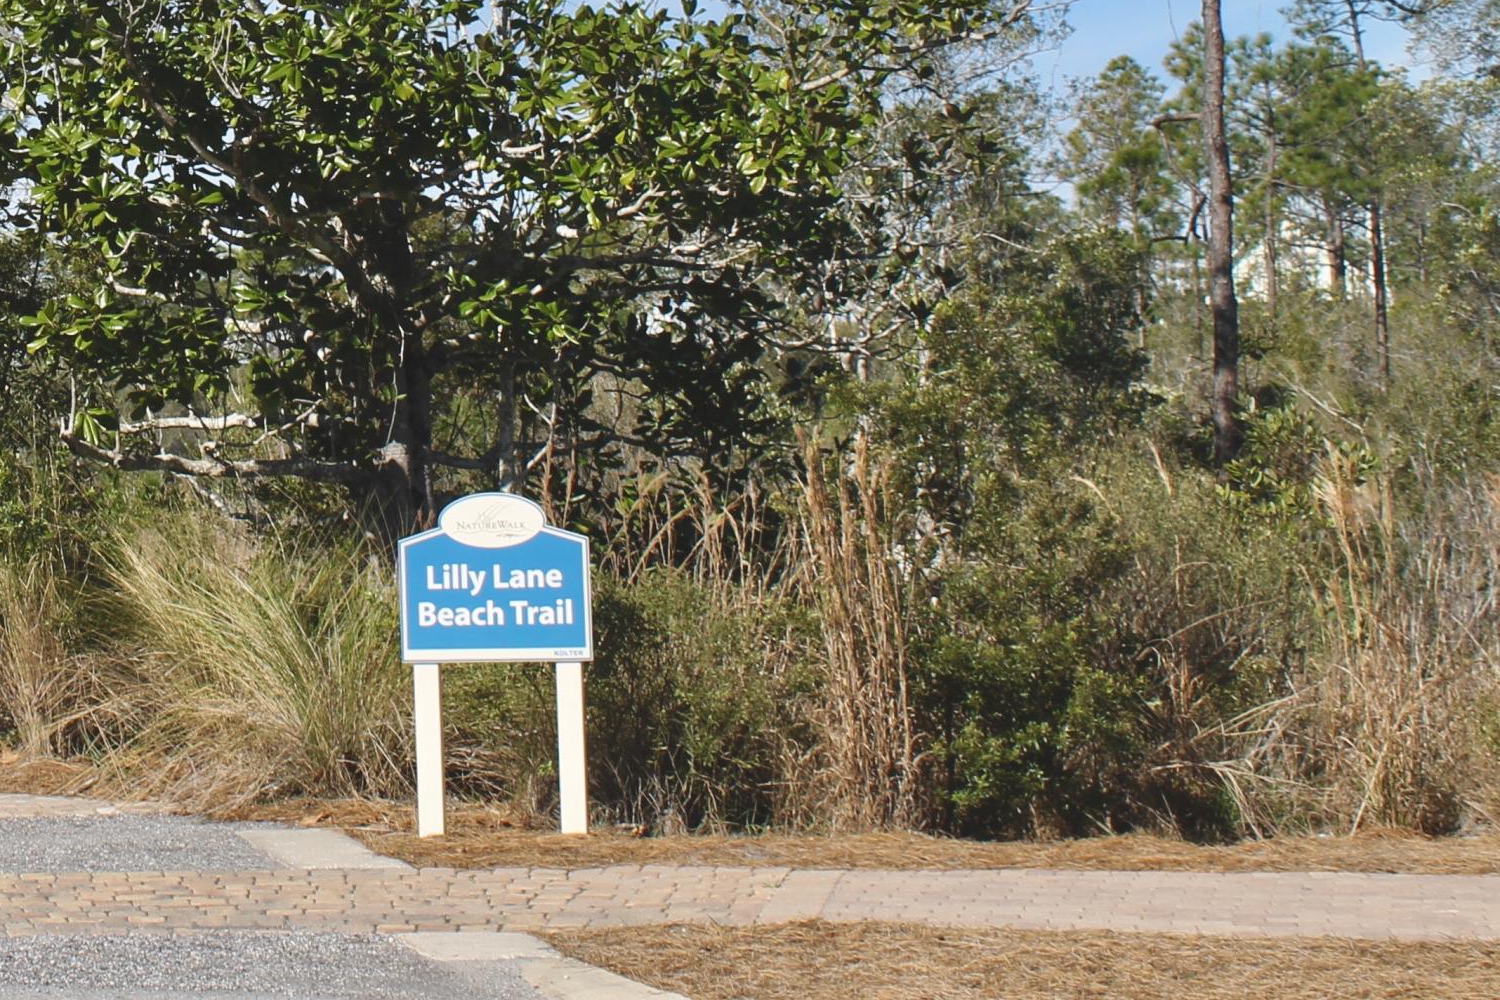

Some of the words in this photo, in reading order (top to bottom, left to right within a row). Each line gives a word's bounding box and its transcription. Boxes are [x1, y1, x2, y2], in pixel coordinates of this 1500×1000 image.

[426, 564, 486, 596] Lilly
[493, 564, 563, 589] Lane
[418, 600, 505, 627] Beach
[509, 598, 574, 626] Trail
